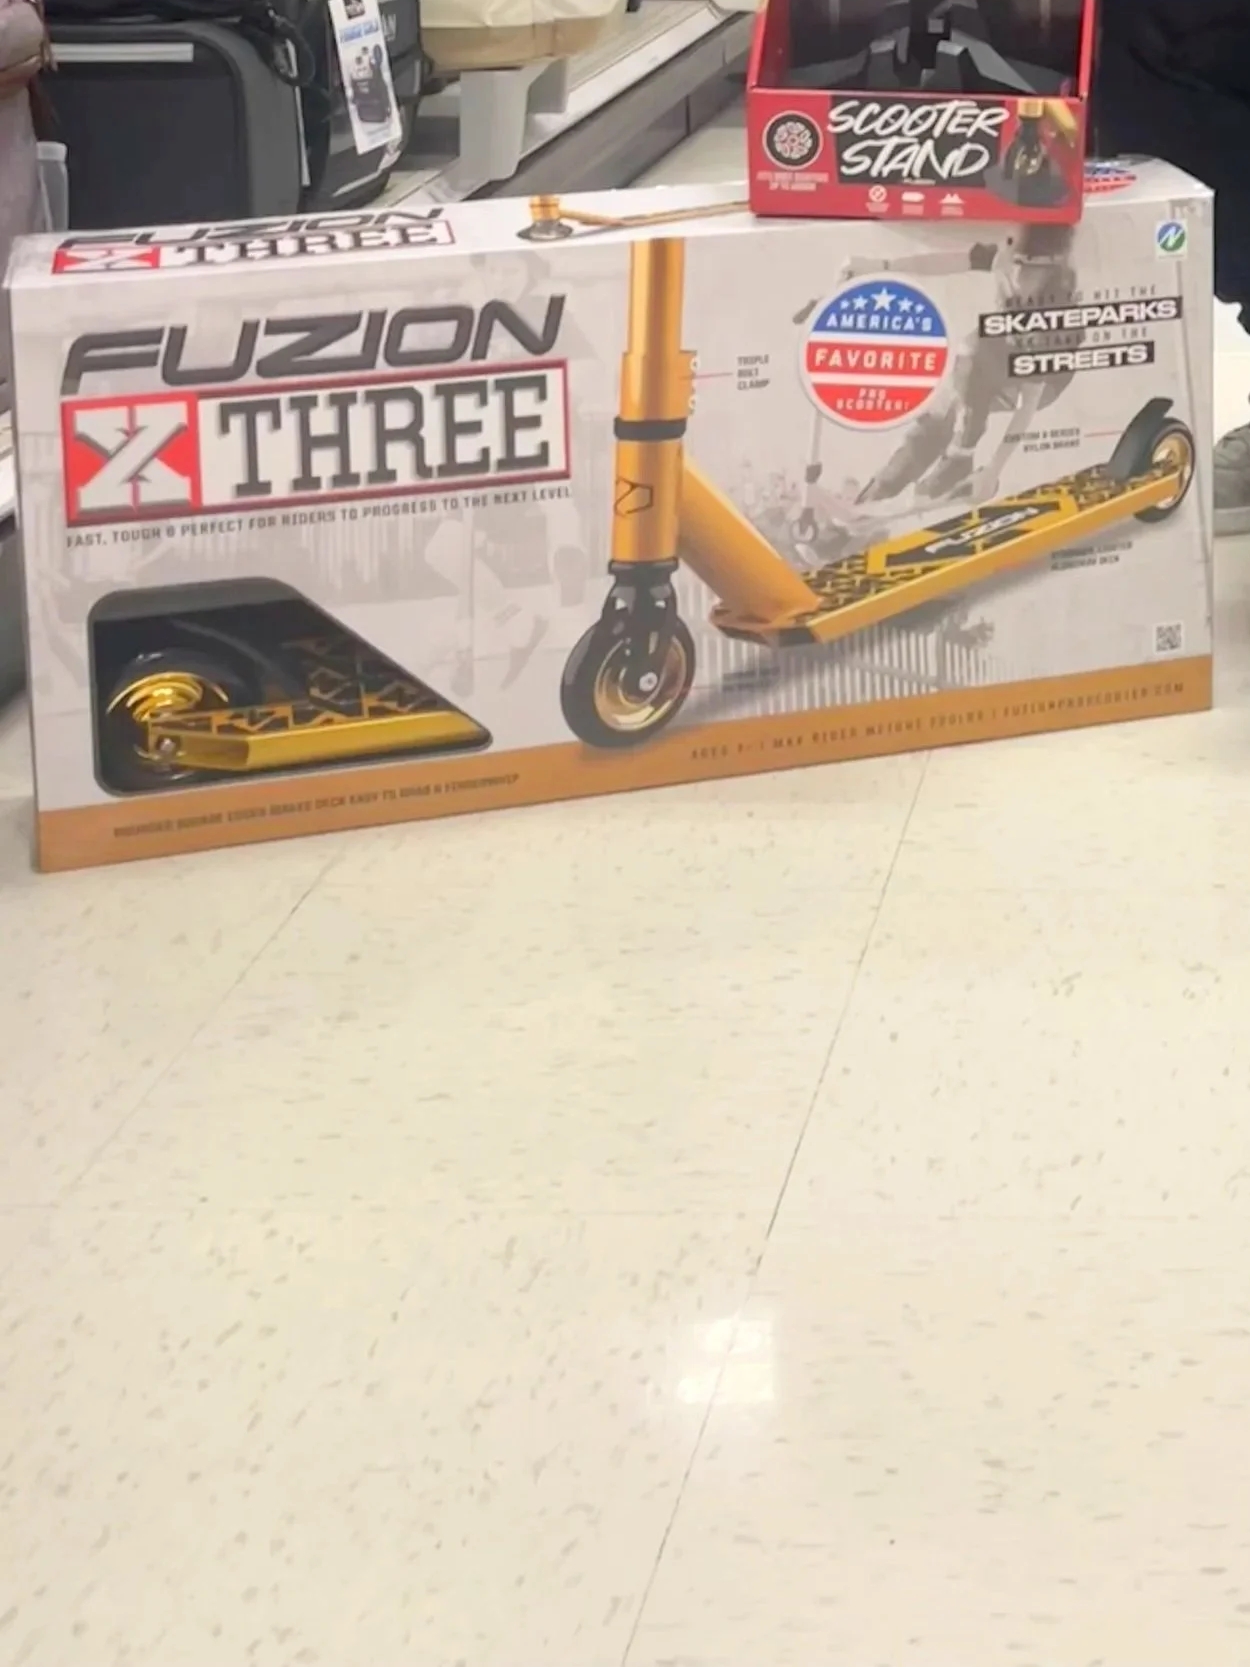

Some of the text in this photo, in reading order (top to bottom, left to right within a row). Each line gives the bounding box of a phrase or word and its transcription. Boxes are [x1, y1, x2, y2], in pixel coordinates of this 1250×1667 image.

[827, 100, 1009, 138] SCOOTER
[840, 136, 990, 180] STAND
[57, 208, 444, 250] FUZION
[172, 223, 438, 268] THREE
[1093, 288, 1119, 300] HIT
[1130, 285, 1157, 296] THE
[825, 312, 934, 333] AMERICA'S
[983, 299, 1178, 335] SKATEPARKS
[1121, 327, 1148, 339] THE
[61, 295, 567, 396] FUZION
[815, 347, 937, 372] FAVORITE
[1012, 344, 1149, 376] STREETS
[72, 374, 551, 514] X THREE
[112, 526, 161, 544] TOUGH
[180, 518, 243, 538] PERFECT
[248, 516, 276, 531] FOR
[281, 508, 336, 527] RIDERS
[341, 508, 357, 522] TO
[362, 499, 437, 518] PROGRESS
[442, 498, 459, 511] TO
[463, 495, 488, 509] THE
[493, 491, 528, 505] NEXT
[531, 486, 571, 501] LEVEL
[864, 717, 923, 736] WEIGHT
